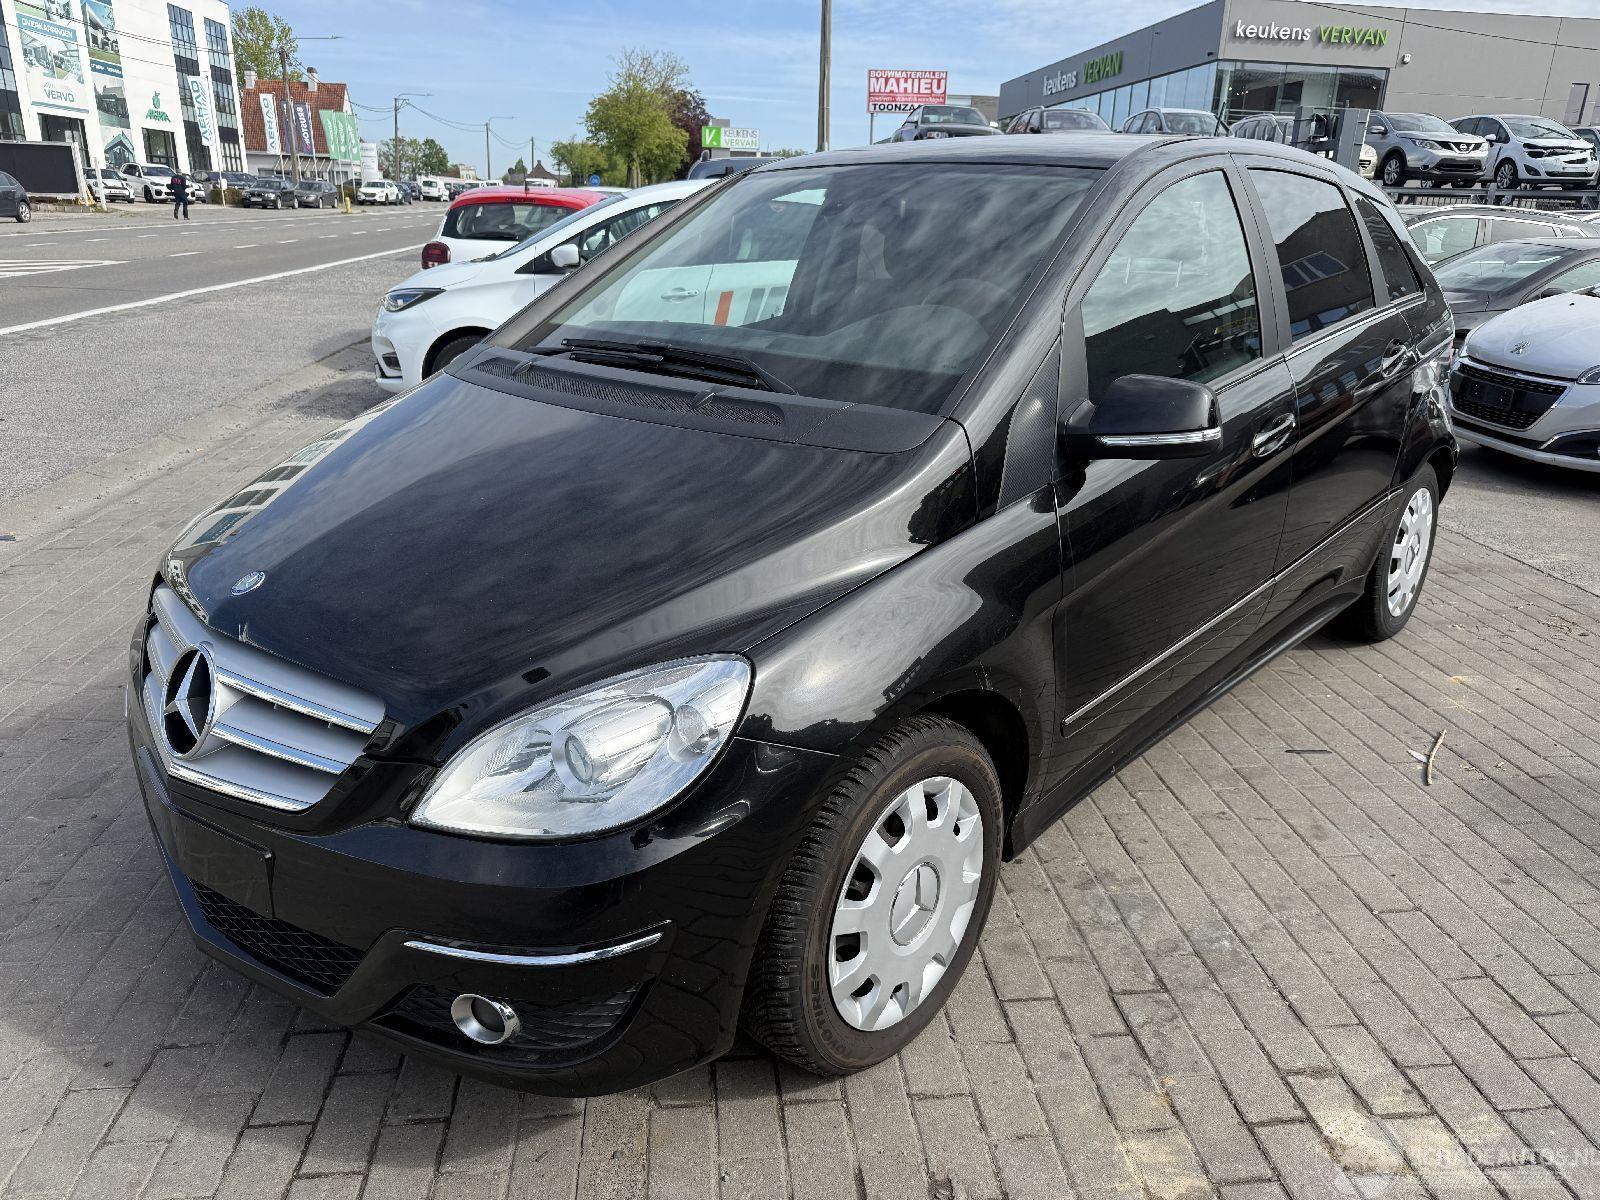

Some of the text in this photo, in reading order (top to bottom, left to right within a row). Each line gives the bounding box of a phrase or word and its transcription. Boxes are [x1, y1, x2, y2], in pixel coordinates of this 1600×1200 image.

[1235, 19, 1390, 46] keukens VERVAN
[870, 70, 946, 78] BOUWMATERIALEN
[1043, 51, 1123, 96] keukens VERVAN
[869, 78, 946, 94] MAHIEU
[43, 88, 75, 102] VERVO
[872, 103, 921, 111] TOONZA
[725, 139, 758, 148] VERVAN
